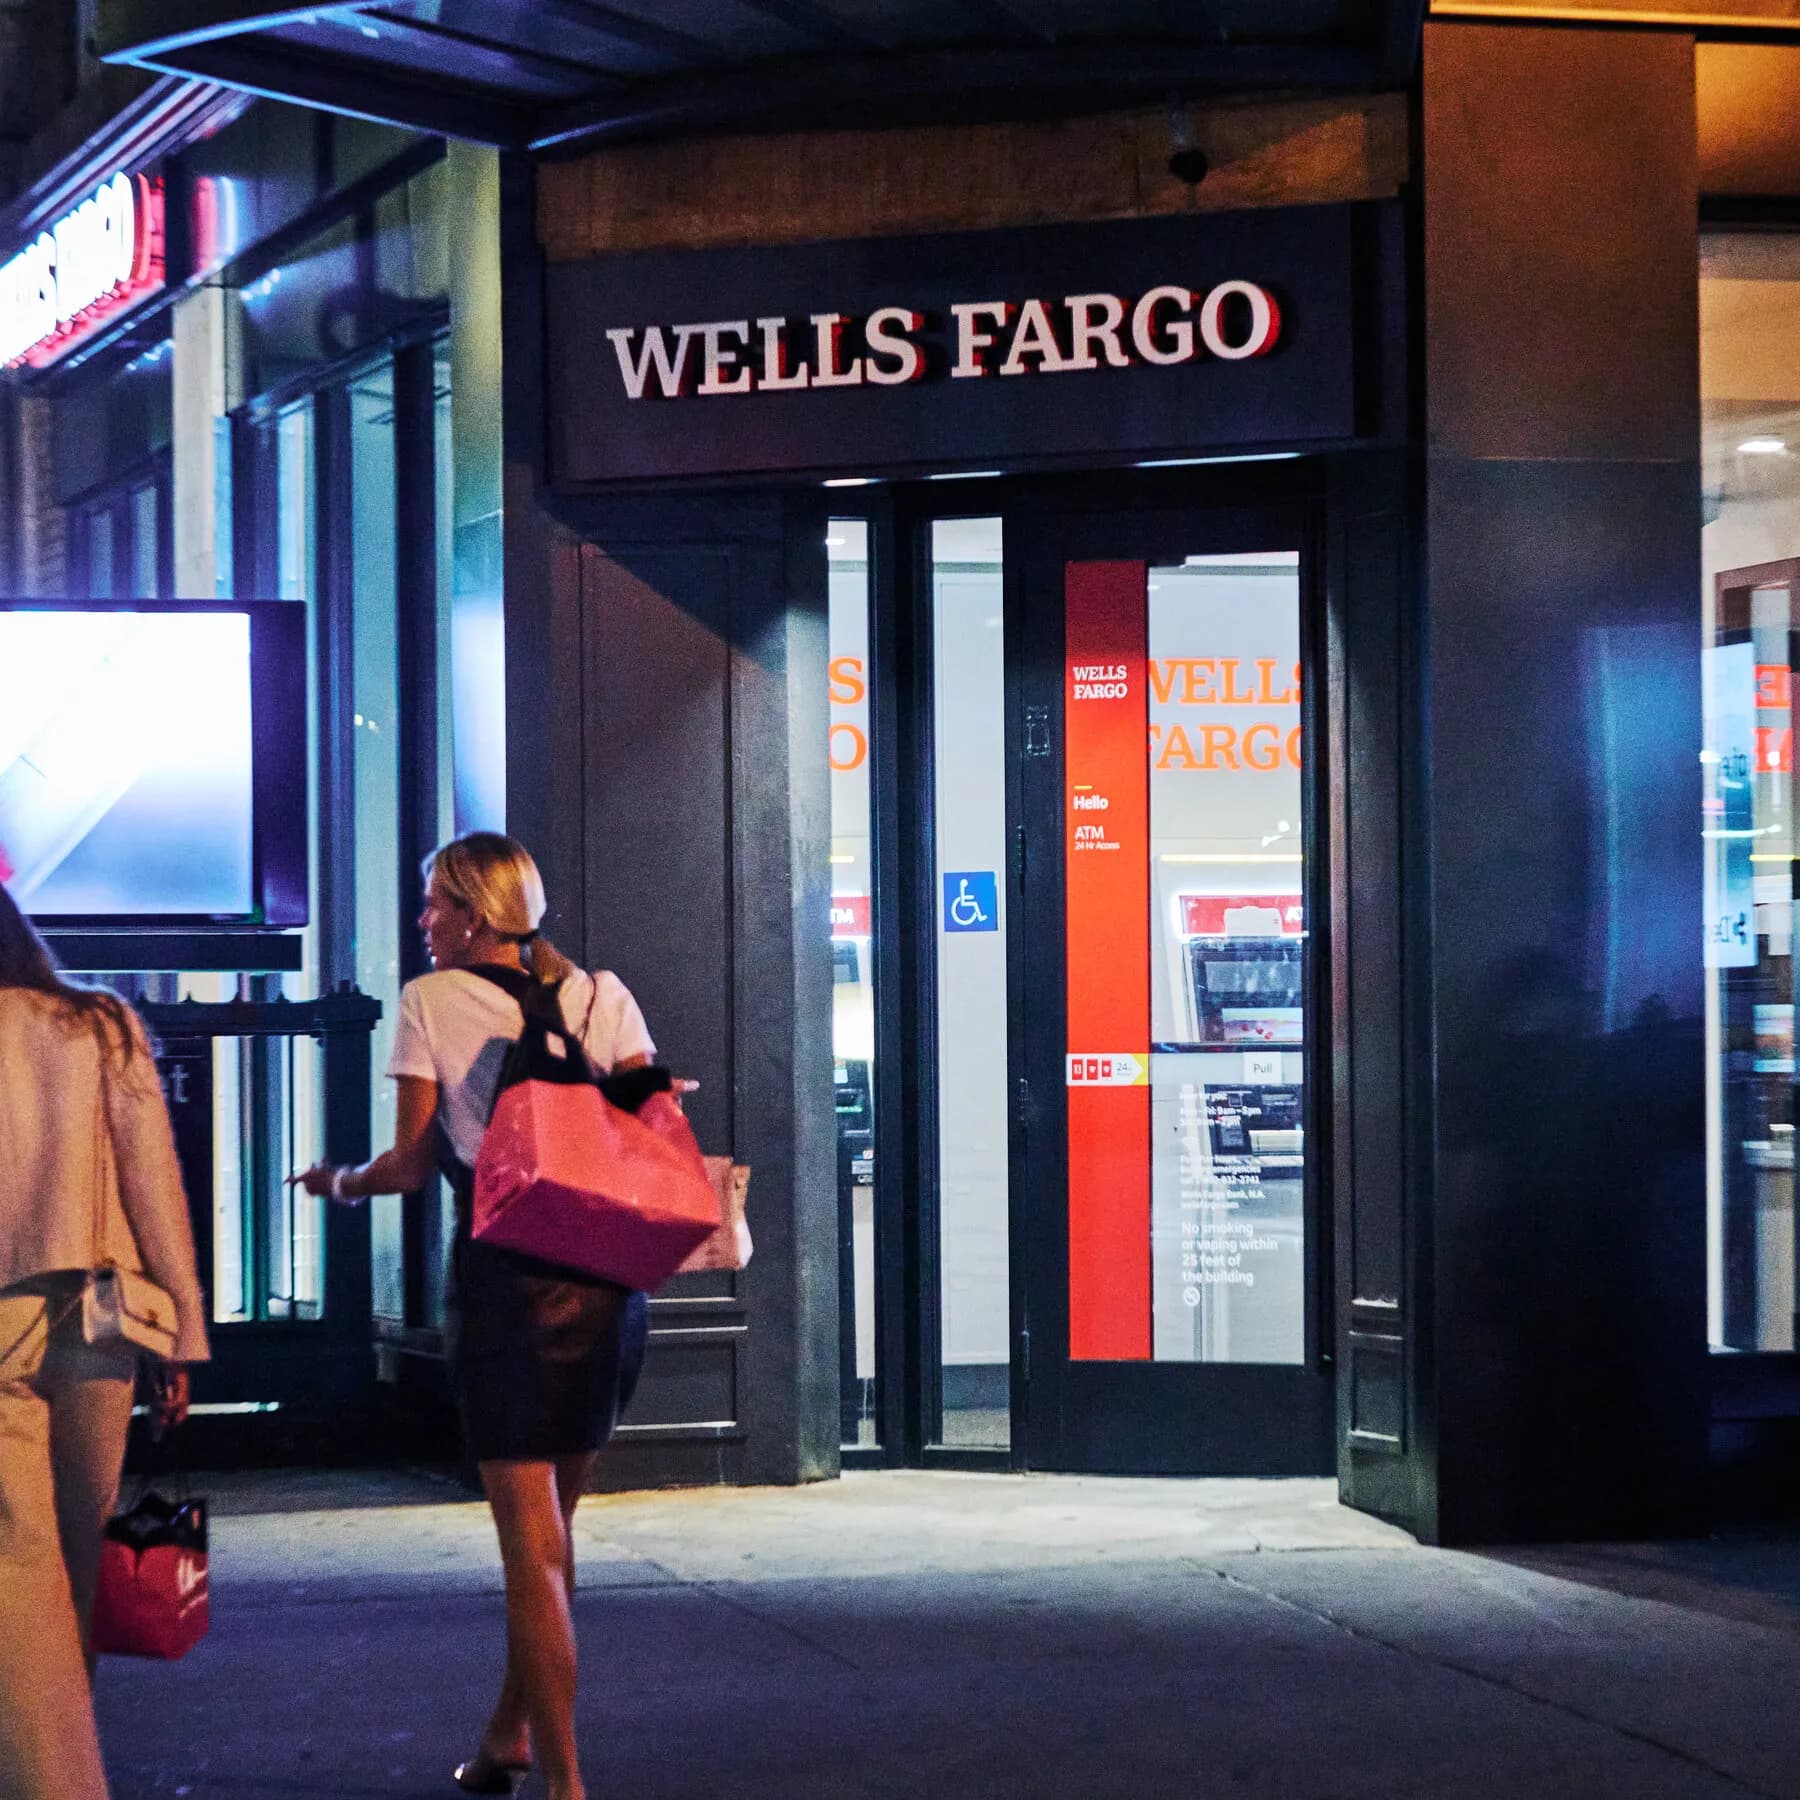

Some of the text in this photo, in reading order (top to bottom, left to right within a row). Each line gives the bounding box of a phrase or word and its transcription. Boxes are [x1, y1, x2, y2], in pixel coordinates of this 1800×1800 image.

[606, 280, 1280, 398] WELLS FARGO
[1072, 665, 1128, 681] WELLS
[1073, 682, 1128, 700] FARGO
[1073, 794, 1109, 810] Hello
[1074, 825, 1105, 840] ATM
[830, 908, 855, 924] TM
[1253, 1063, 1273, 1073] Pull
[1182, 1222, 1254, 1237] No smoking
[1182, 1238, 1279, 1253] or vaping within
[1200, 1253, 1225, 1267] feet
[1227, 1253, 1242, 1267] of
[1182, 1270, 1254, 1287] the building
